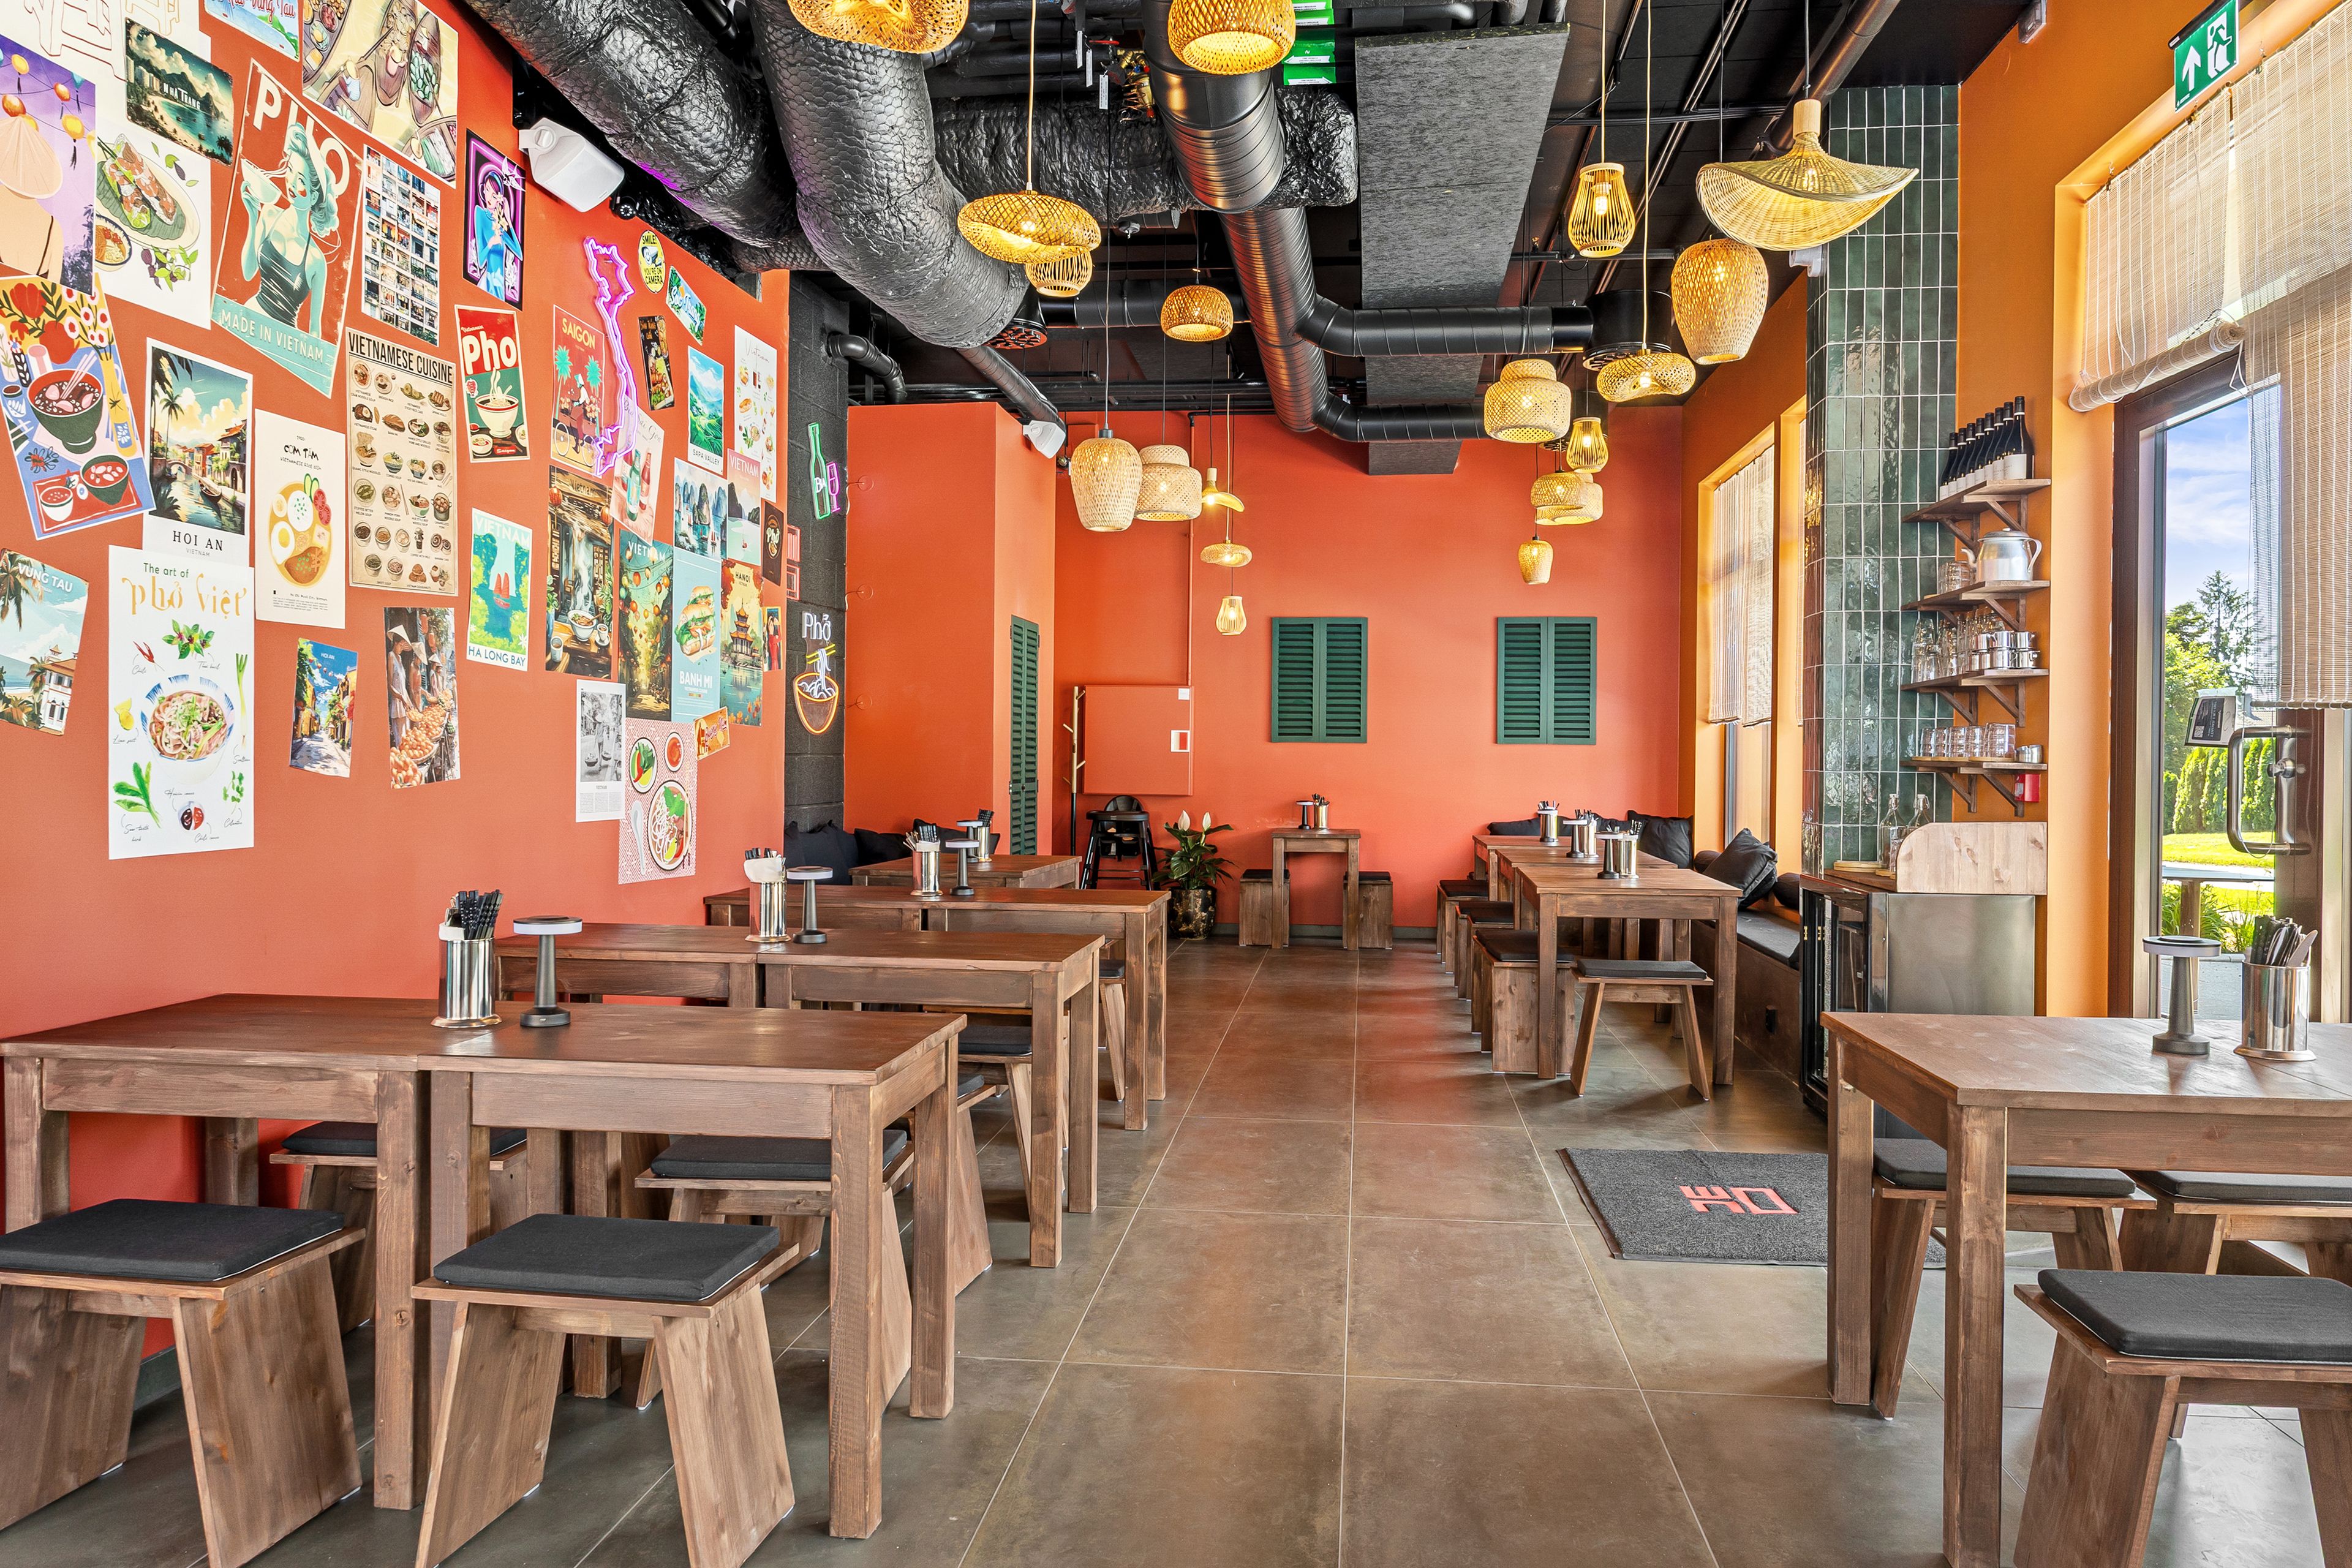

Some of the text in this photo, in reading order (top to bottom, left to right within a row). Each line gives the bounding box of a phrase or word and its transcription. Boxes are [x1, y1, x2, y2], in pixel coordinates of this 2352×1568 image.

[163, 83, 201, 110] NHA TRANG
[644, 267, 662, 276] YOU'RE ON
[645, 276, 663, 285] CAMERA
[221, 309, 323, 363] MADE IN VIETNAM
[562, 317, 595, 350] SAIGON
[349, 332, 453, 384] VIETNAMESE CUISINE
[462, 331, 517, 375] Pho
[693, 449, 720, 466] SAPA VALLEY
[729, 454, 759, 478] VIETNAM
[173, 530, 223, 551] HOI AN
[474, 513, 530, 548] VIETNAM
[186, 548, 210, 557] VIETNAM
[628, 540, 665, 562] VIETM
[18, 562, 73, 592] VUNG TAU
[143, 562, 189, 578] The art of
[469, 646, 526, 666] HA LONG BAY
[679, 671, 712, 689] BANH MI
